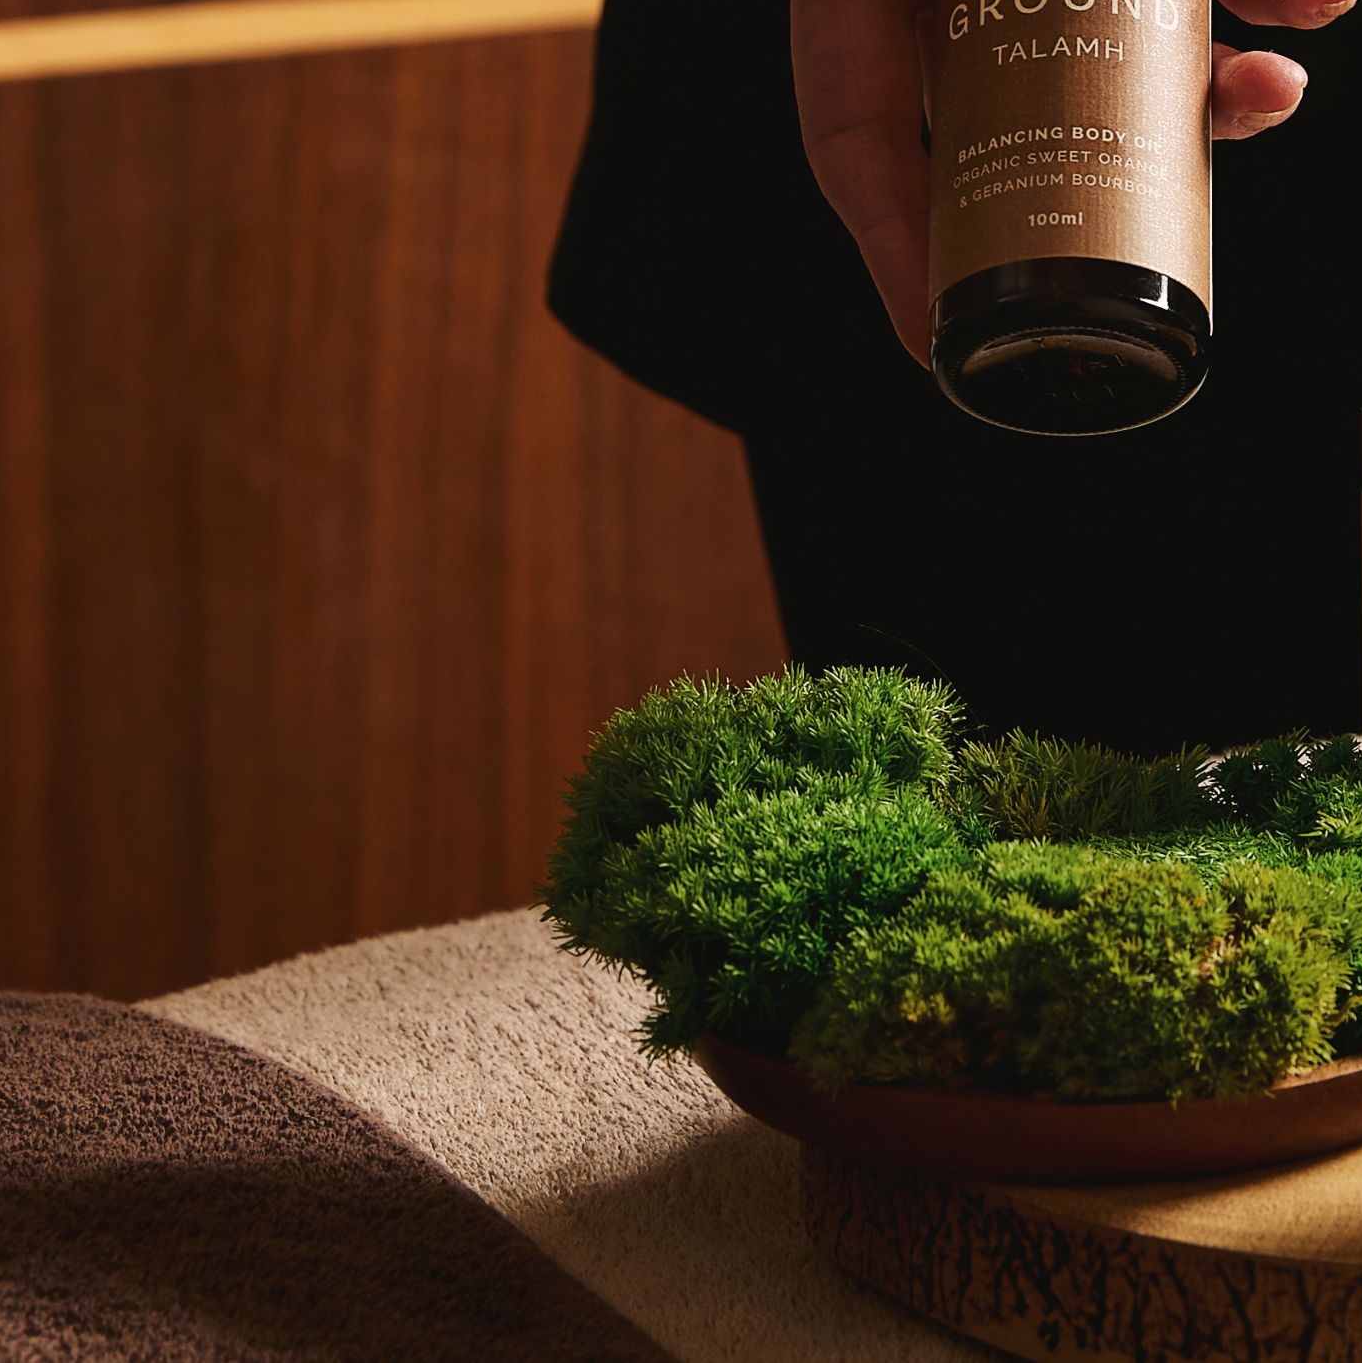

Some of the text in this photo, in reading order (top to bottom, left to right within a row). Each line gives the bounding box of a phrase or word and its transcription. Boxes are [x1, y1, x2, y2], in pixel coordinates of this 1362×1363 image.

[992, 36, 1124, 66] TALAMH
[958, 126, 1162, 164] BALANCING BODY OIL
[953, 155, 1021, 189] ORGANIC
[1027, 150, 1092, 165] SWEET
[959, 196, 968, 208] &
[972, 173, 1064, 201] GERANIUM
[1028, 211, 1083, 227] 100ml
